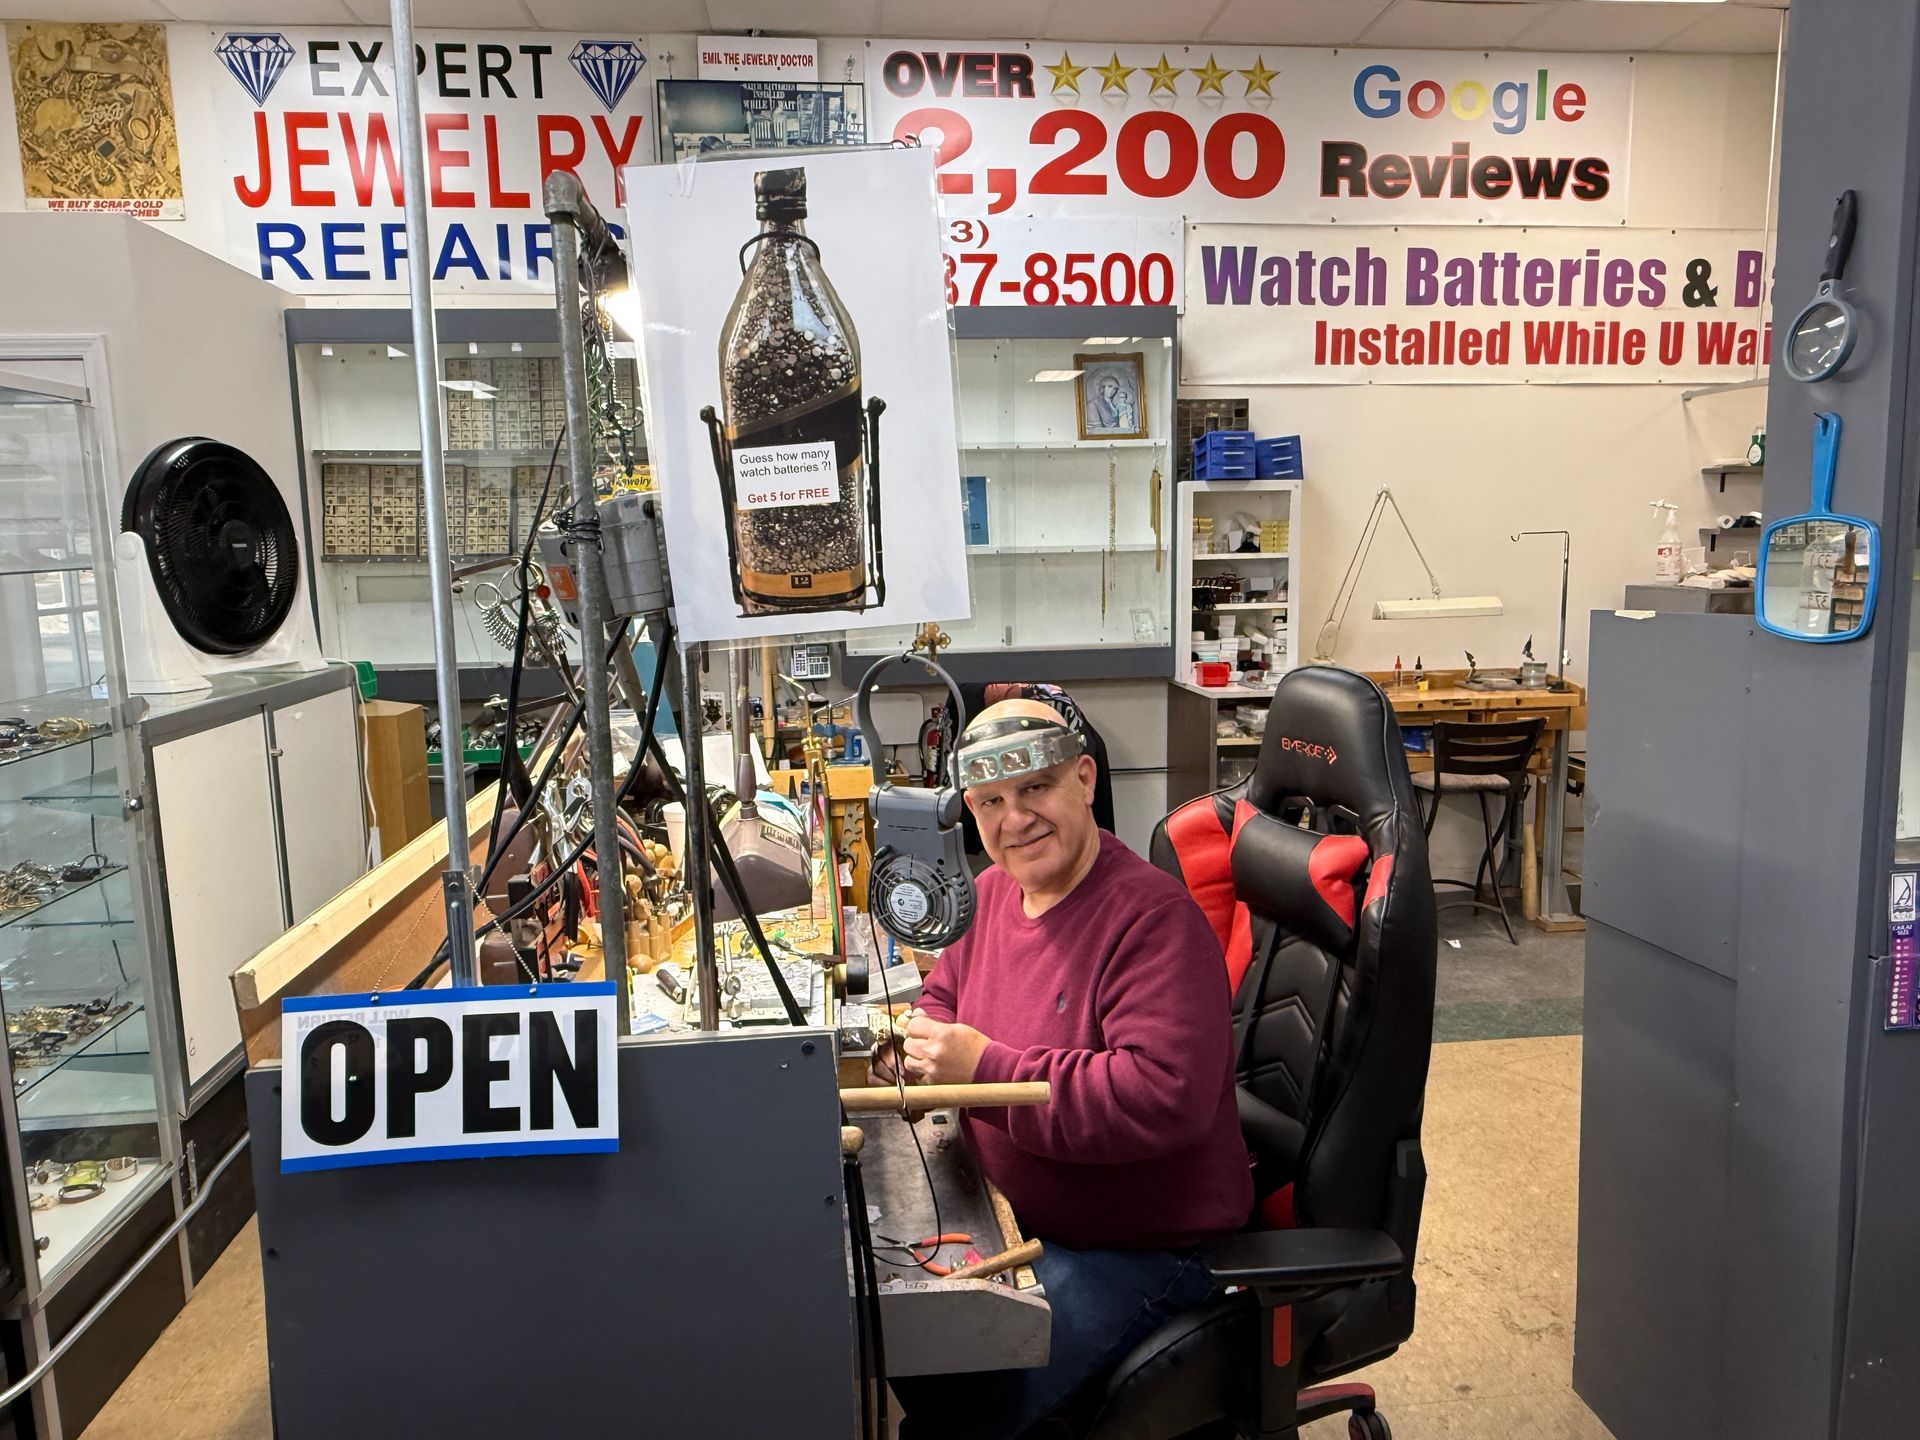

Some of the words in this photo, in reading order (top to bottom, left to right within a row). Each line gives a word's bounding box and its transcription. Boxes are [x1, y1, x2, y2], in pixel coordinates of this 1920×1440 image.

[308, 41, 552, 99] EXERT
[702, 52, 722, 65] EMIL
[724, 52, 740, 65] THE
[742, 53, 778, 66] JEWELRY
[780, 54, 813, 67] DOCTOR
[883, 50, 1035, 98] OVER
[743, 99, 768, 109] WHILE
[1353, 65, 1587, 134] Google
[234, 111, 643, 209] JEWELRY
[893, 108, 1285, 215] 2,200
[1320, 140, 1610, 201] Reviews
[48, 200, 65, 209] WE
[68, 200, 92, 209] BUY
[93, 200, 131, 209] SCRAP
[133, 200, 164, 209] GOLD
[1201, 246, 1387, 308] Watch
[1405, 247, 1667, 308] Batteries
[1682, 258, 1718, 308] &
[1314, 320, 1511, 366] Installed
[1523, 320, 1646, 366] While
[1659, 321, 1686, 366] U
[740, 454, 774, 465] Guess
[776, 452, 798, 462] how
[801, 450, 830, 460] many
[740, 466, 771, 477] watch
[774, 463, 819, 475] batteries
[747, 493, 768, 504] Get
[770, 492, 777, 502] 5
[780, 491, 796, 501] for
[798, 487, 830, 499] FREE
[793, 576, 810, 585] 12
[300, 1009, 599, 1147] OPEN
